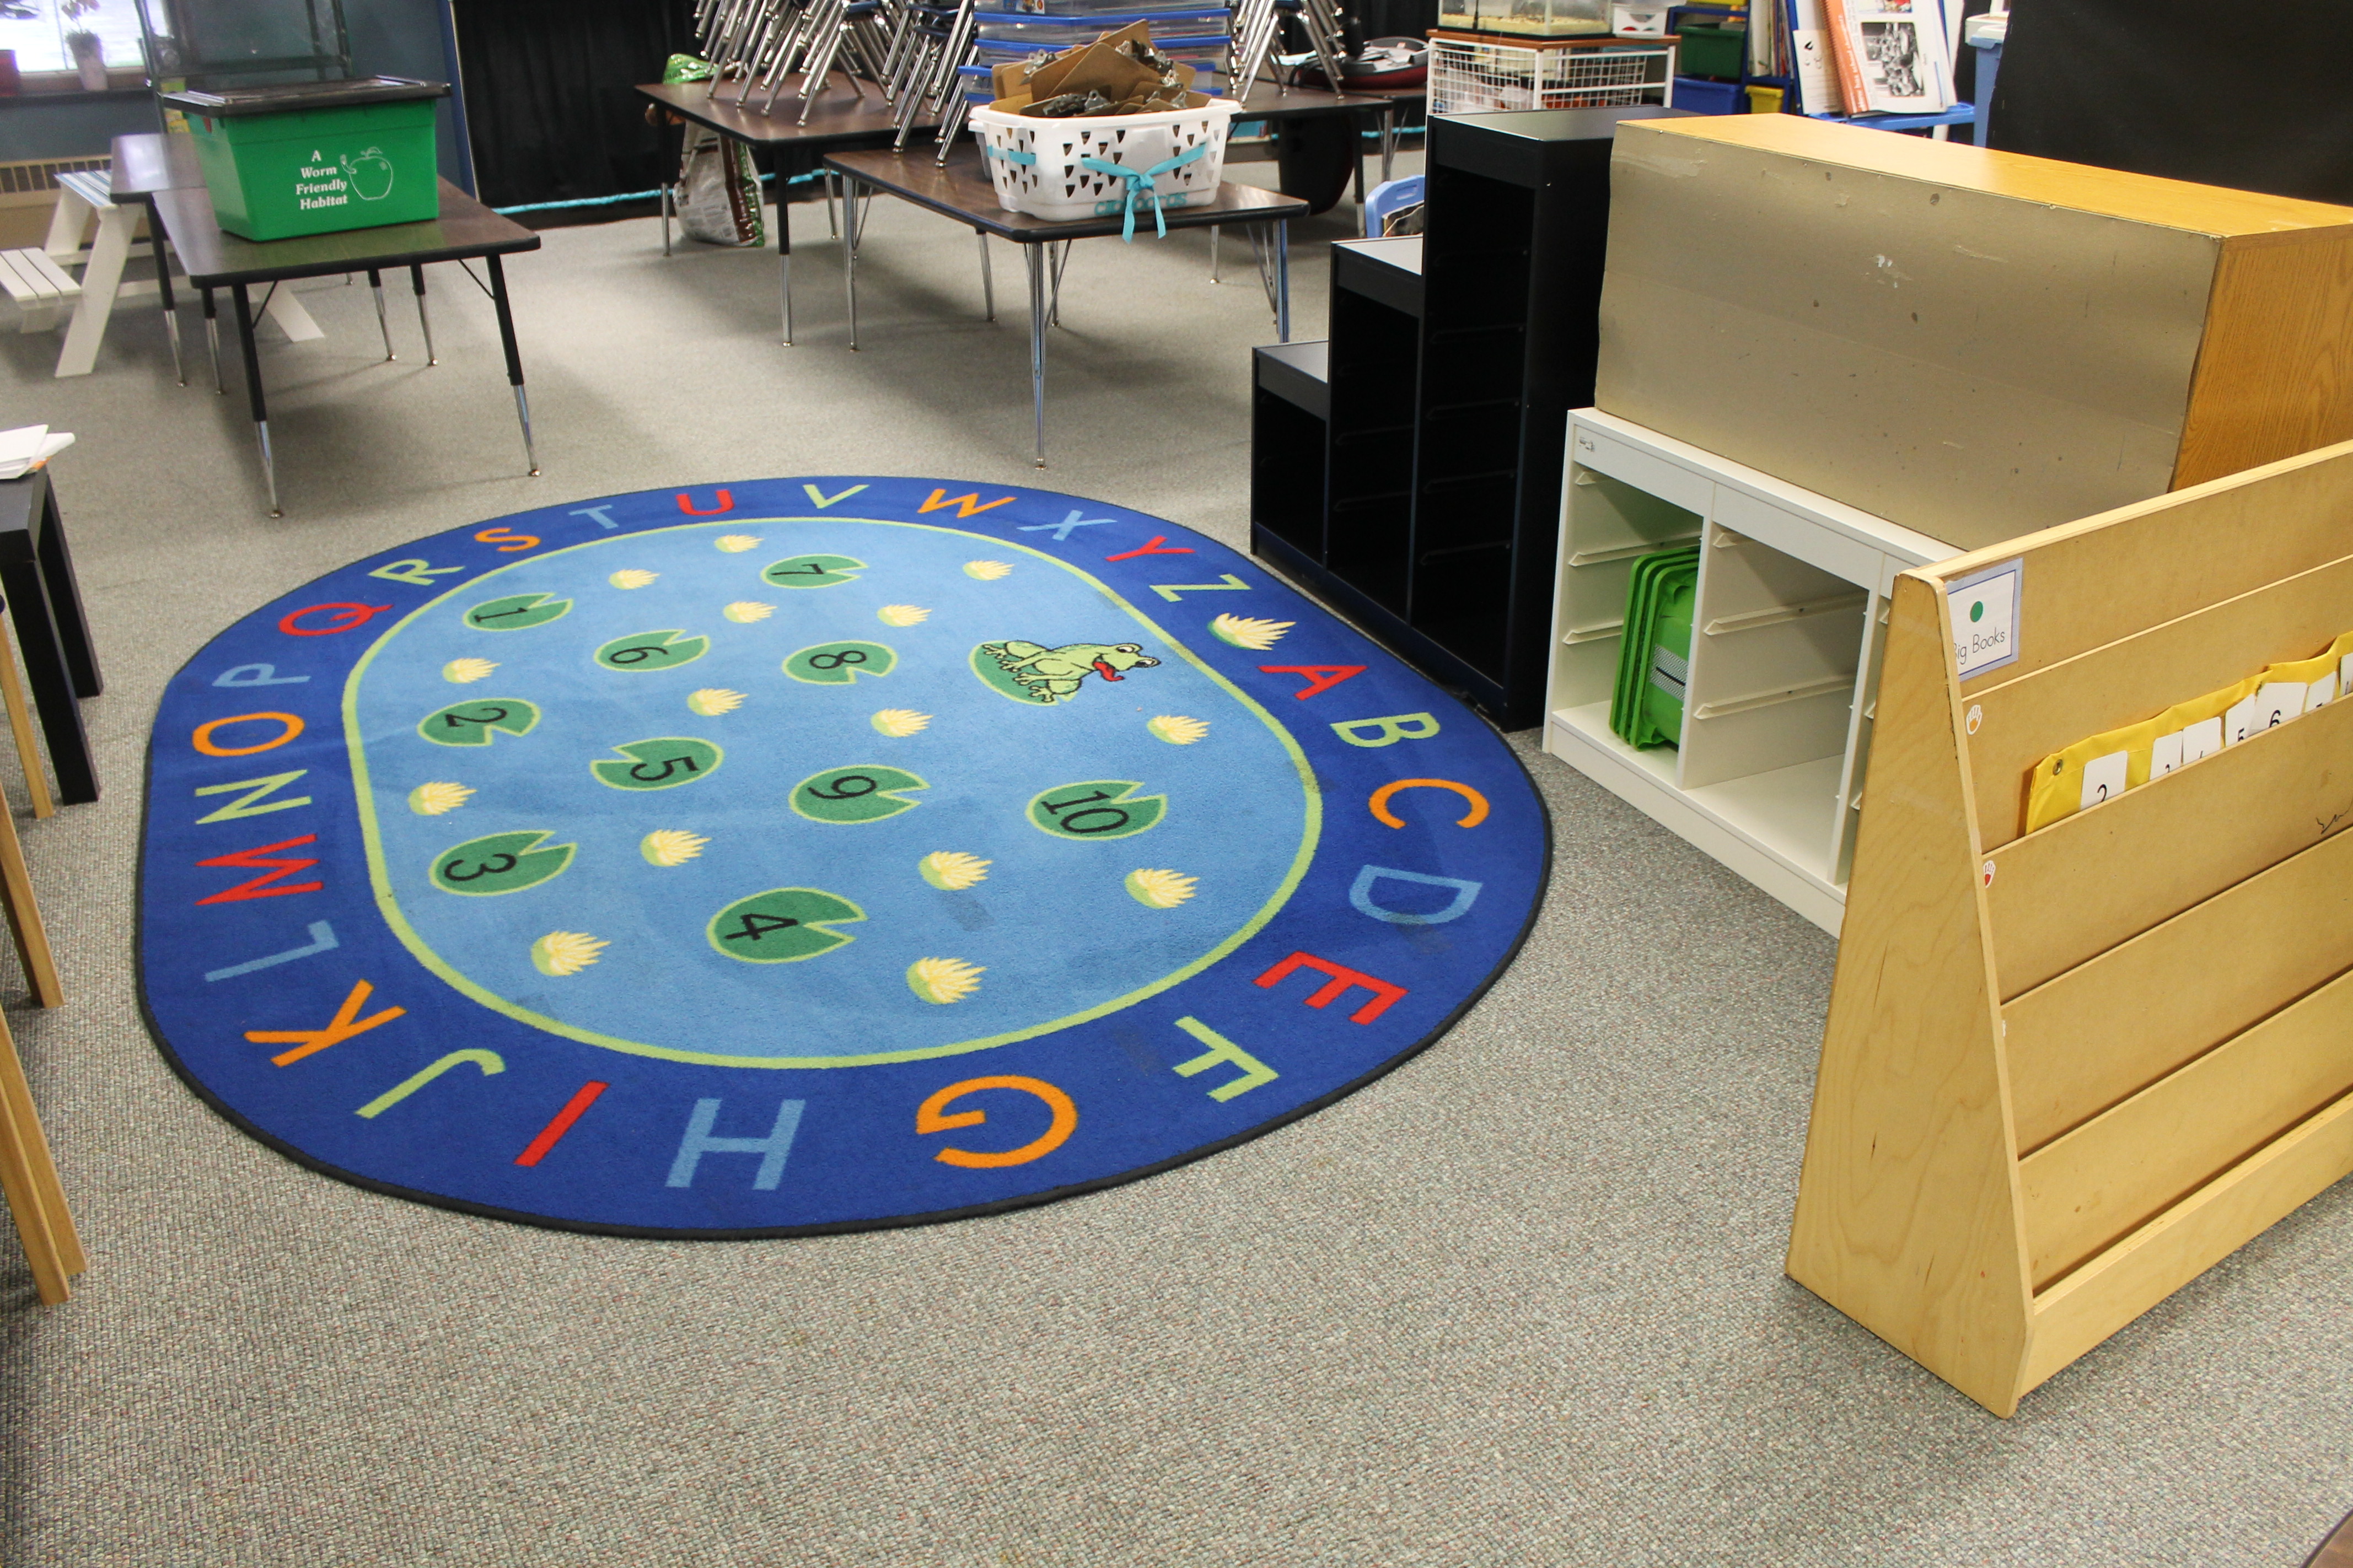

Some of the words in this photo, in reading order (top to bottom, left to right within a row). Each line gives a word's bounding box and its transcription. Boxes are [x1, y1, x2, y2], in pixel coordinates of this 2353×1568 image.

[311, 150, 322, 162] A
[300, 166, 337, 179] Worm
[296, 179, 347, 196] Friendly
[300, 195, 348, 211] Habitat
[675, 489, 735, 516] U
[803, 484, 868, 509] V
[918, 488, 1016, 518] W
[566, 503, 621, 531] T
[1017, 510, 1118, 541] X
[474, 527, 542, 552] S
[1105, 535, 1195, 562] Y
[368, 558, 463, 586] R
[771, 563, 825, 578] 7
[1150, 573, 1251, 602] Z
[277, 602, 393, 637] Q
[474, 607, 528, 623] 1
[1972, 627, 2006, 654] Books
[809, 650, 867, 670] 8
[211, 662, 313, 688] P
[1257, 665, 1368, 701] A
[444, 707, 508, 728] 2
[1330, 712, 1441, 748] B
[191, 711, 306, 757] O
[629, 756, 699, 782] 5
[194, 769, 313, 825] N
[1368, 778, 1491, 829] C
[1041, 790, 1130, 834] 10
[194, 833, 324, 906] M
[443, 853, 518, 882] 3
[1348, 864, 1484, 925] D
[724, 913, 800, 941] 4
[205, 919, 340, 982] L
[1252, 950, 1409, 1026] E
[243, 979, 407, 1068] K
[1173, 1016, 1280, 1103] F
[354, 1048, 506, 1119] J
[514, 1081, 609, 1167] I
[915, 1074, 1079, 1169] G
[665, 1097, 807, 1190] H
